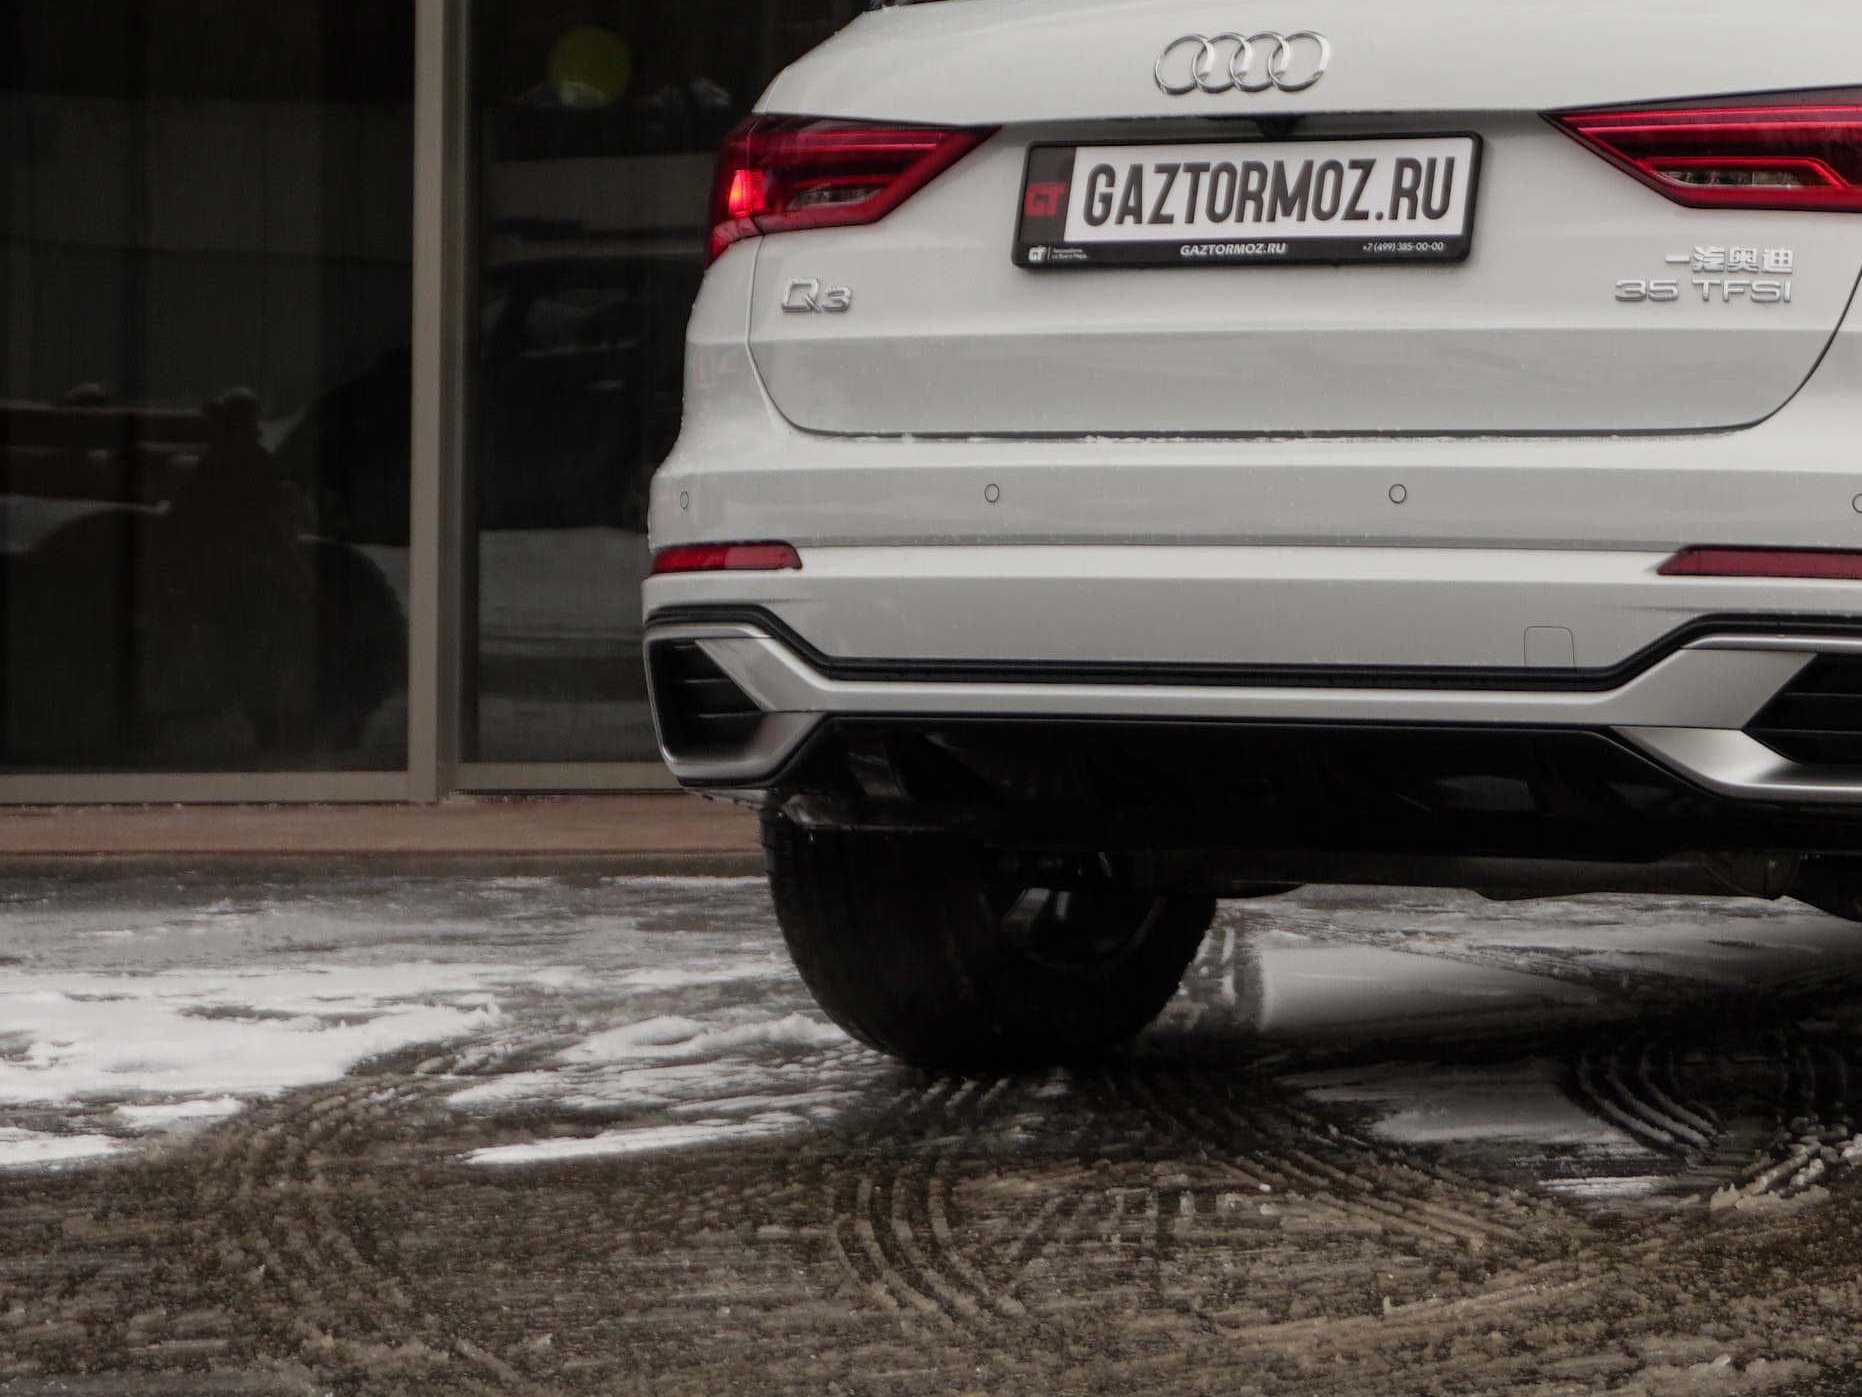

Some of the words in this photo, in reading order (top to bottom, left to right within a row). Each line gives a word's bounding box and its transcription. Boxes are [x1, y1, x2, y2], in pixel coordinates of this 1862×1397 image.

[1082, 156, 1456, 227] GAZTORMOZ.RU
[1179, 242, 1287, 257] GAZTORMOZ.RU
[781, 277, 852, 313] Q3
[1615, 279, 1680, 302] 35
[1692, 279, 1792, 302] TFSI
